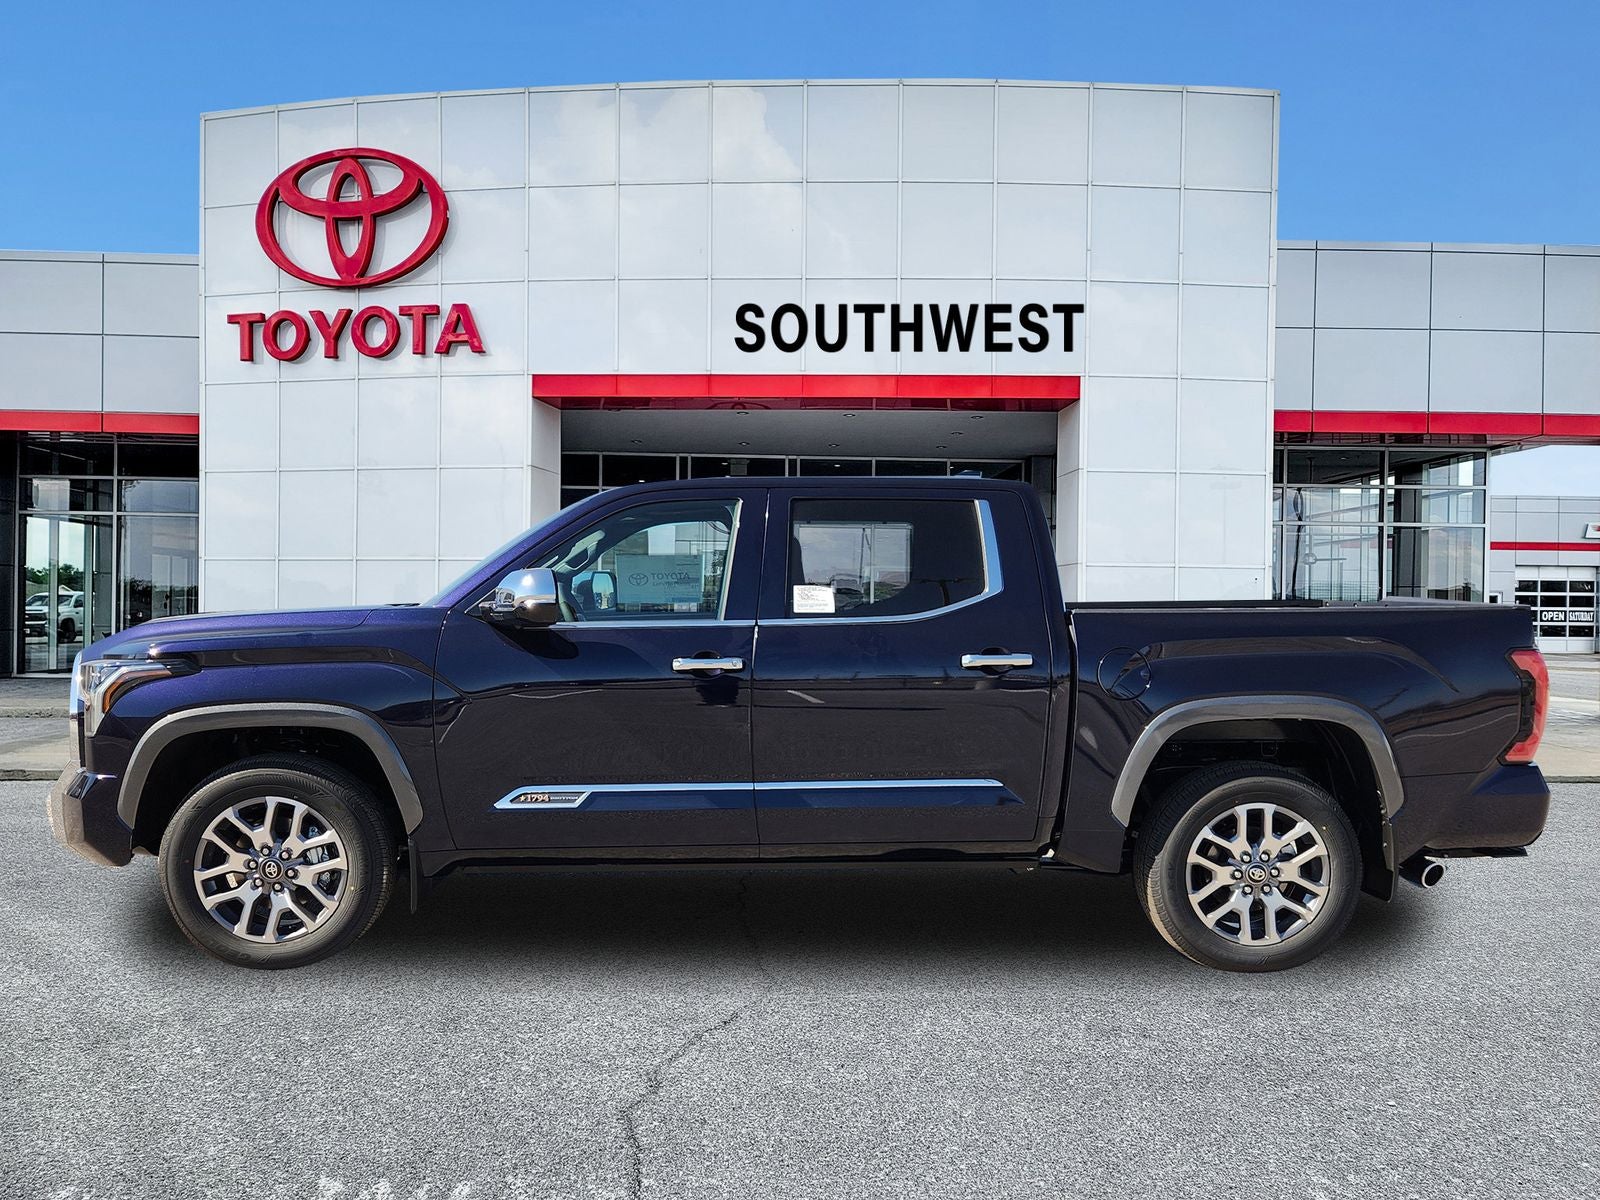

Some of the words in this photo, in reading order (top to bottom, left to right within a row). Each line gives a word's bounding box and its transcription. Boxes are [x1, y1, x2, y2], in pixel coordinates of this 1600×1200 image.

[226, 303, 486, 362] TOYOTA
[734, 303, 1084, 352] SOUTHWEST
[650, 572, 690, 580] TOYOTA
[1541, 611, 1565, 621] OPEN
[1569, 612, 1594, 621] SATURDAY
[526, 794, 549, 802] 1794
